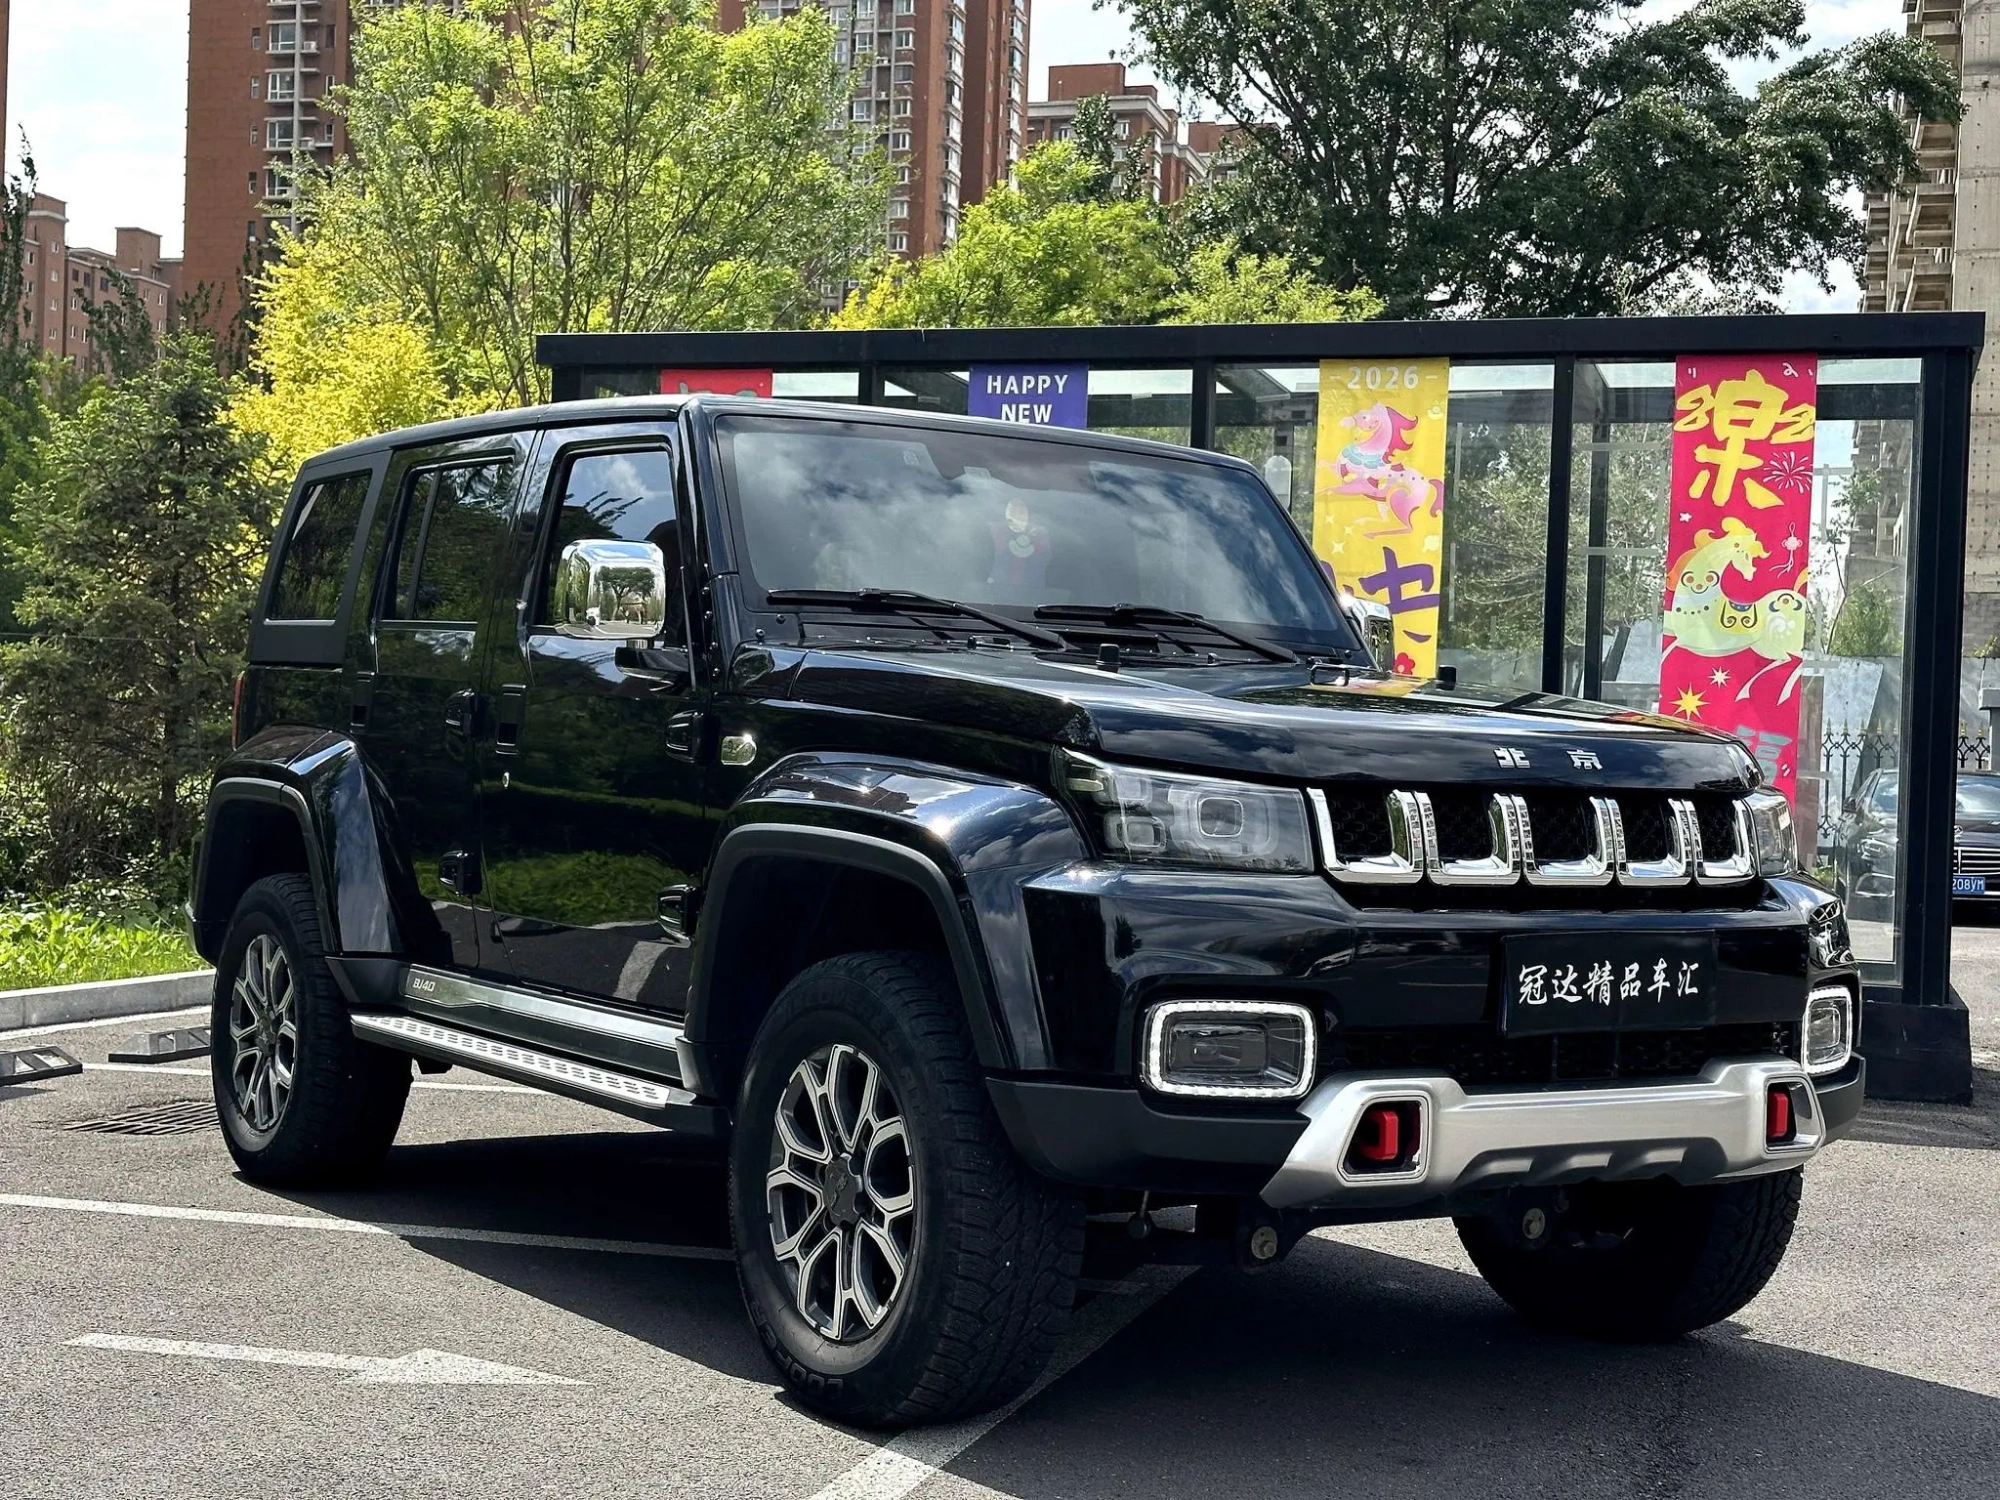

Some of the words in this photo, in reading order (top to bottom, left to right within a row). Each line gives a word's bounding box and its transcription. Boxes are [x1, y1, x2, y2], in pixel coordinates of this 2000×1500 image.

[986, 374, 1069, 395] HAPPY
[1347, 366, 1418, 389] 2026
[1001, 403, 1053, 424] NEW
[1493, 747, 1603, 770] 北京
[1518, 957, 1700, 1006] 冠达精品车汇
